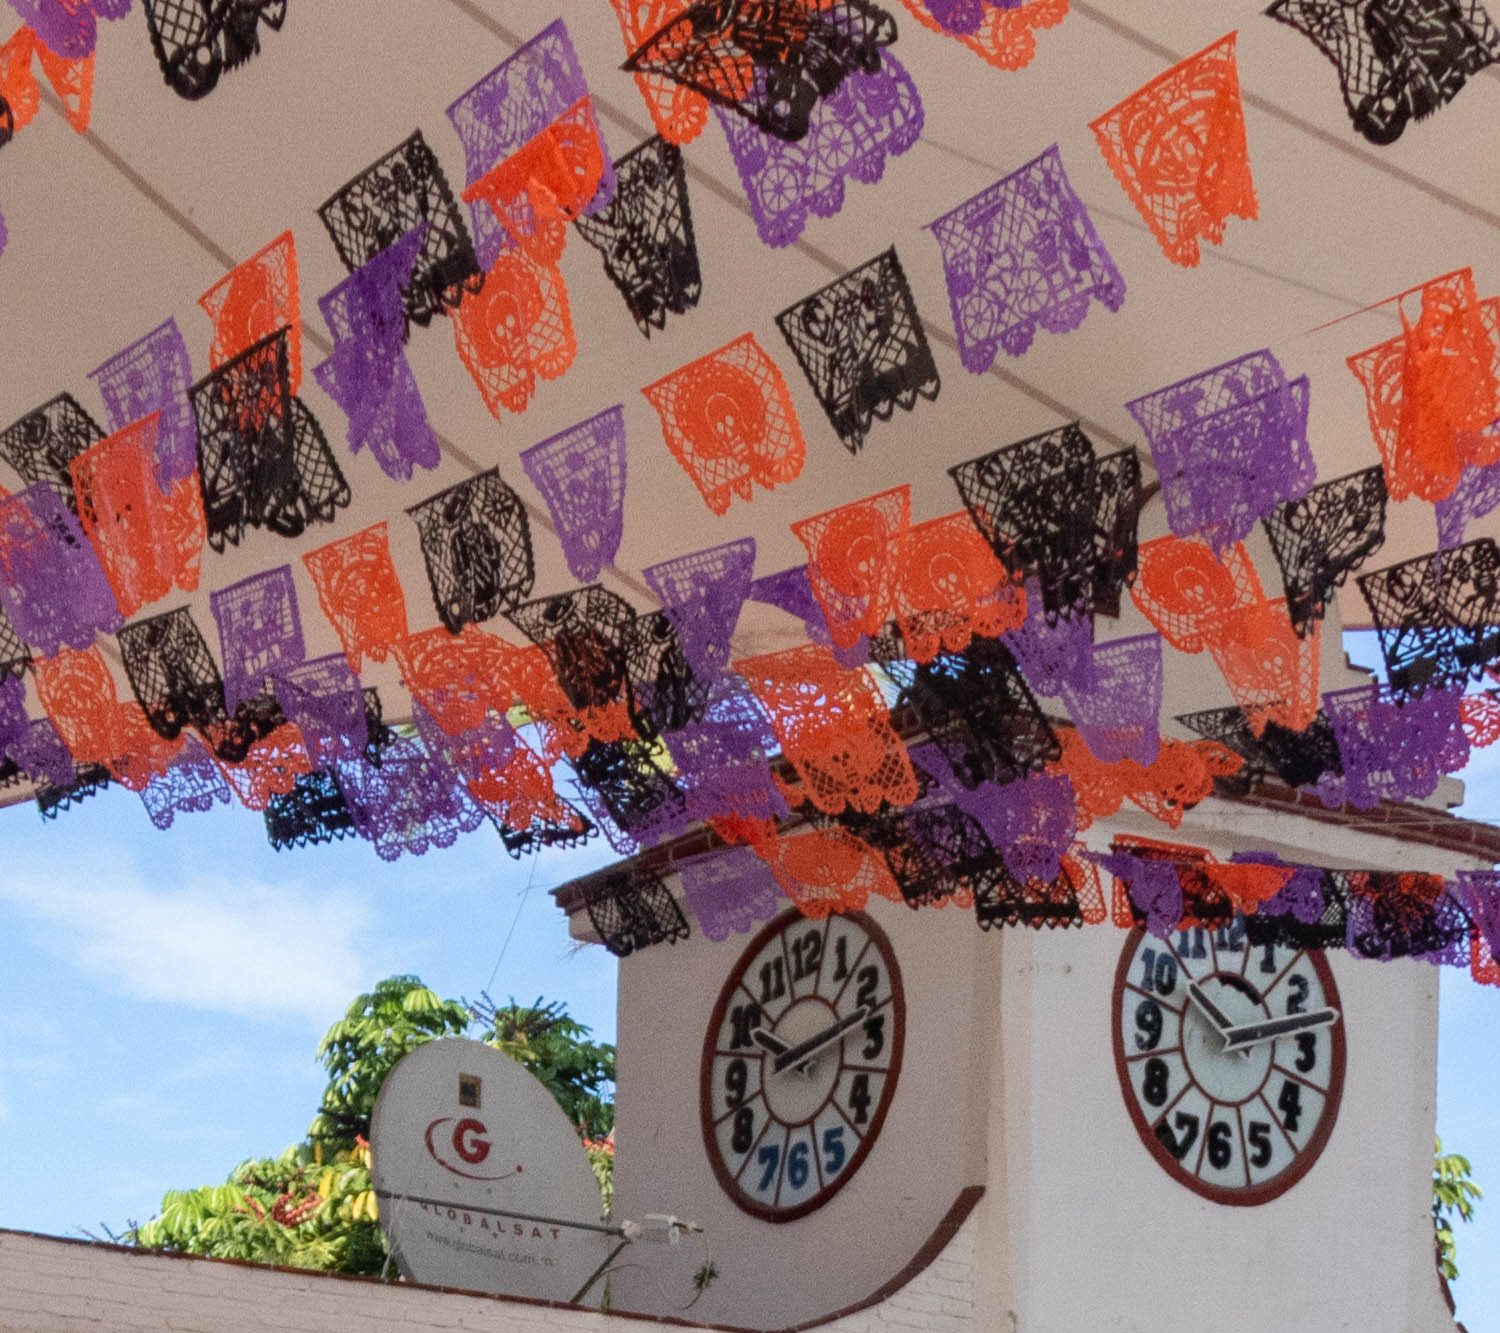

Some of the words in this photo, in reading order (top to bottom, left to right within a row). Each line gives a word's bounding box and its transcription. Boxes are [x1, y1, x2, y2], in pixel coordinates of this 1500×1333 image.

[759, 956, 786, 1003] 11
[791, 929, 822, 982] 12
[833, 935, 848, 982] 1
[1141, 947, 1178, 997] 10
[857, 964, 879, 1008] 2
[1286, 973, 1310, 1016] 2
[729, 1003, 762, 1050] 10
[861, 1014, 885, 1060] 3
[1134, 1000, 1163, 1051] 9
[1295, 1032, 1317, 1073] 3
[724, 1059, 748, 1109] 9
[849, 1073, 872, 1124] 4
[1142, 1057, 1169, 1107] 8
[1277, 1079, 1303, 1132] 4
[452, 1117, 492, 1164] G
[731, 1105, 755, 1154] 8
[823, 1125, 846, 1174] 5
[1172, 1111, 1200, 1160] 7
[1206, 1120, 1233, 1170] 6
[1247, 1120, 1273, 1168] 5
[757, 1144, 780, 1192] 7
[787, 1141, 809, 1189] 6
